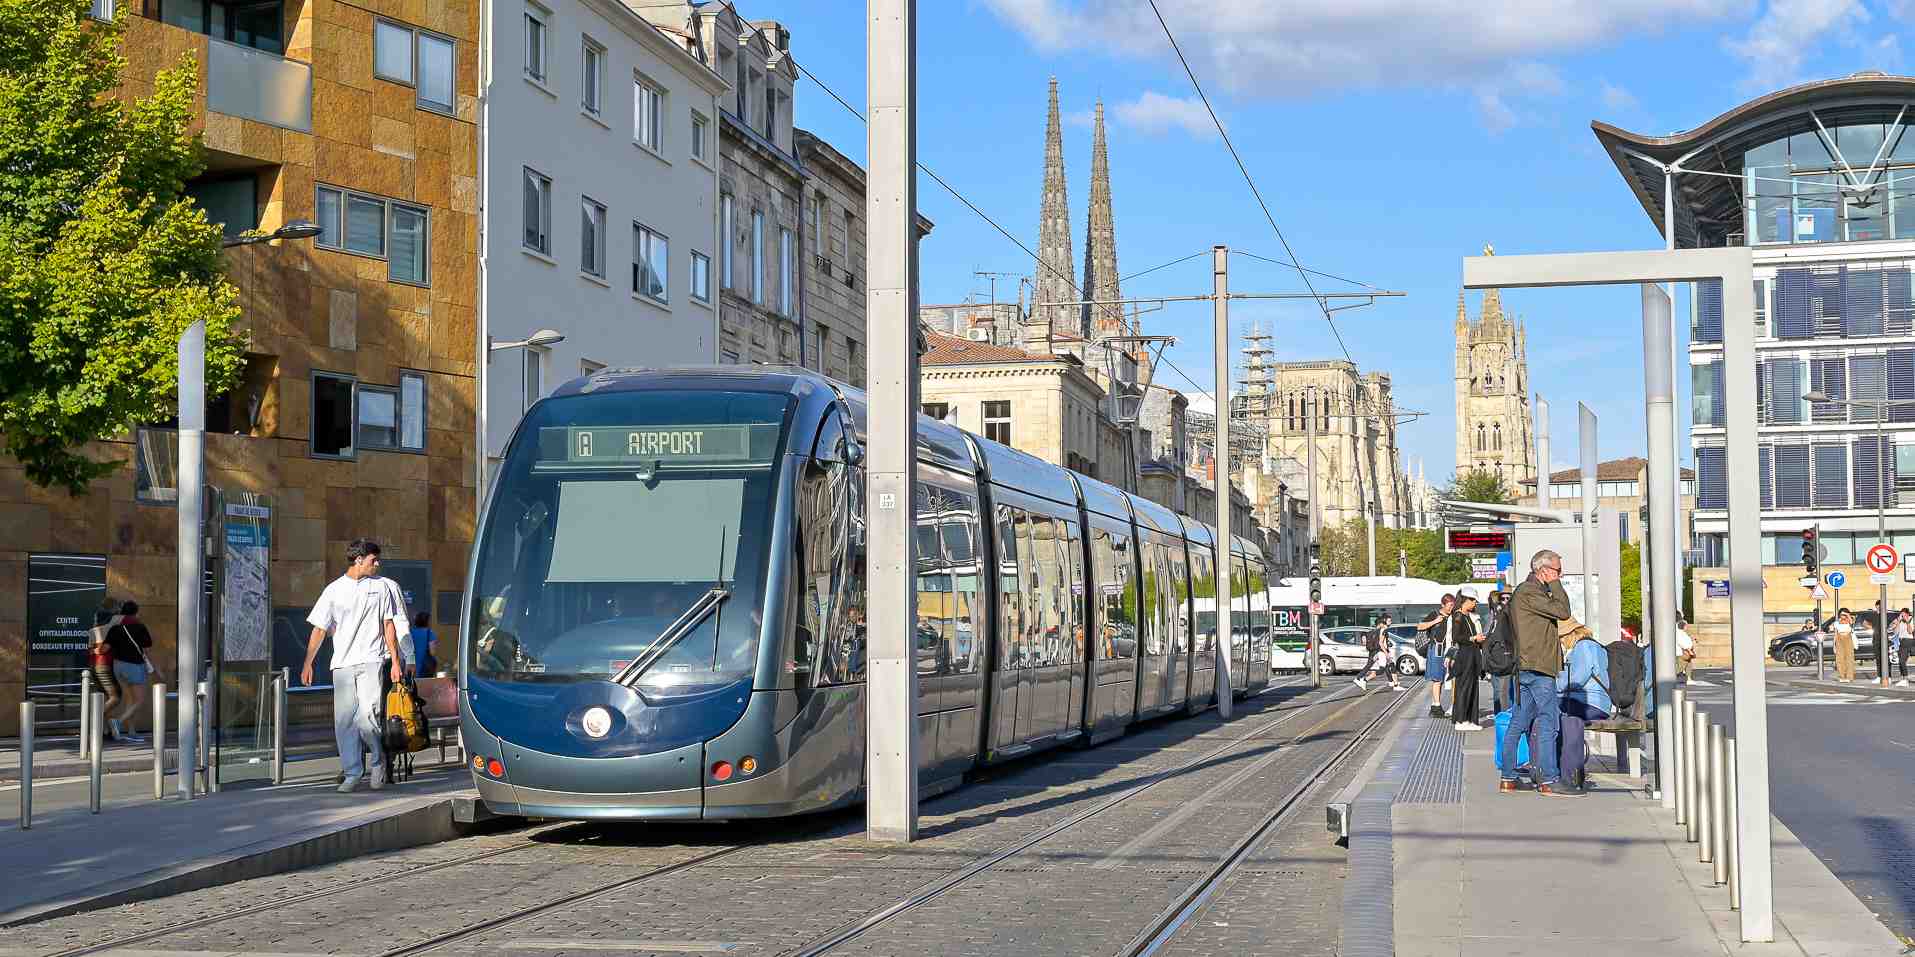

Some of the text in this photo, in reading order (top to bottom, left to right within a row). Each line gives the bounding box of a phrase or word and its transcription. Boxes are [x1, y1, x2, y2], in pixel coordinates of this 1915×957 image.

[580, 432, 703, 456] A AIRPORT
[1271, 610, 1300, 626] TBM
